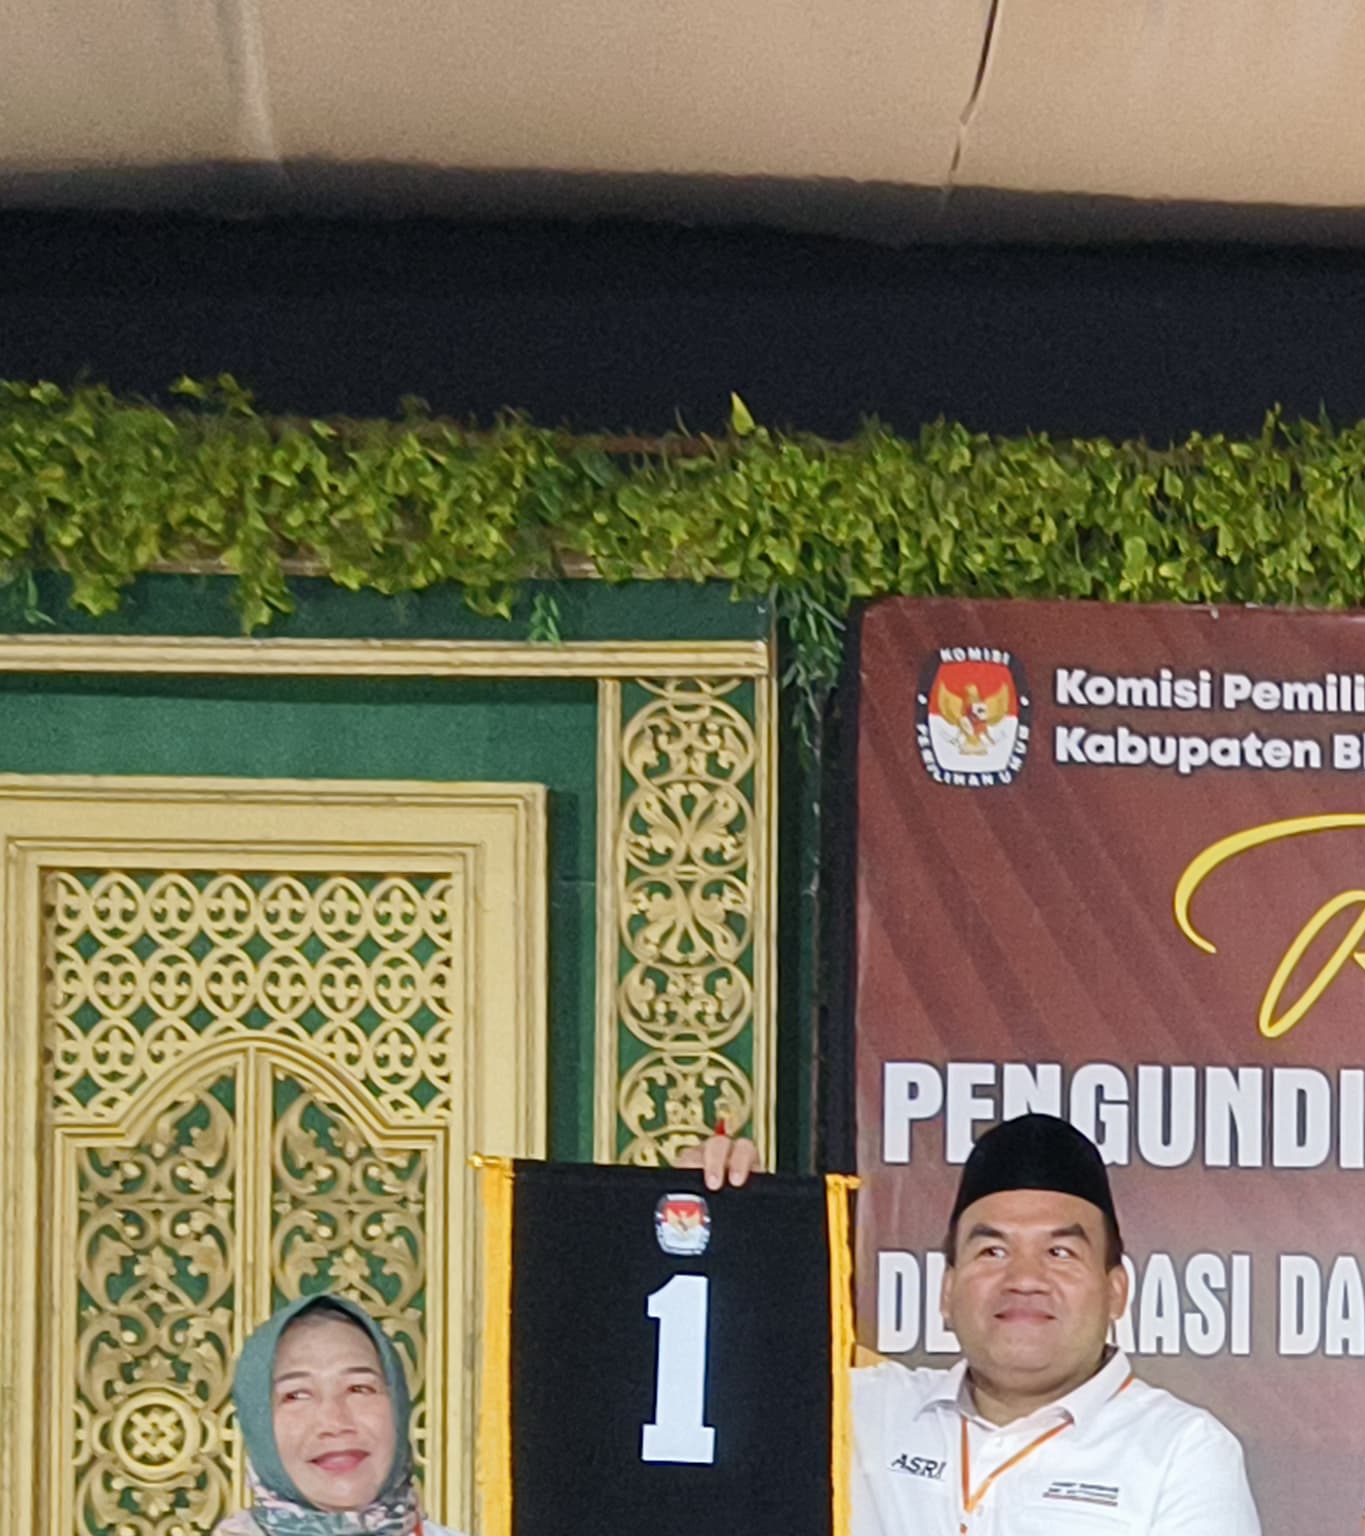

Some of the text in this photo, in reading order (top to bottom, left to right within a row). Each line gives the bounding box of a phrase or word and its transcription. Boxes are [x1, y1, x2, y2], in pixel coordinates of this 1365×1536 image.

[1055, 669, 1212, 709] Komisi
[1055, 726, 1321, 773] Kabupaten
[642, 1274, 715, 1464] 1
[892, 1454, 946, 1480] ASRI
